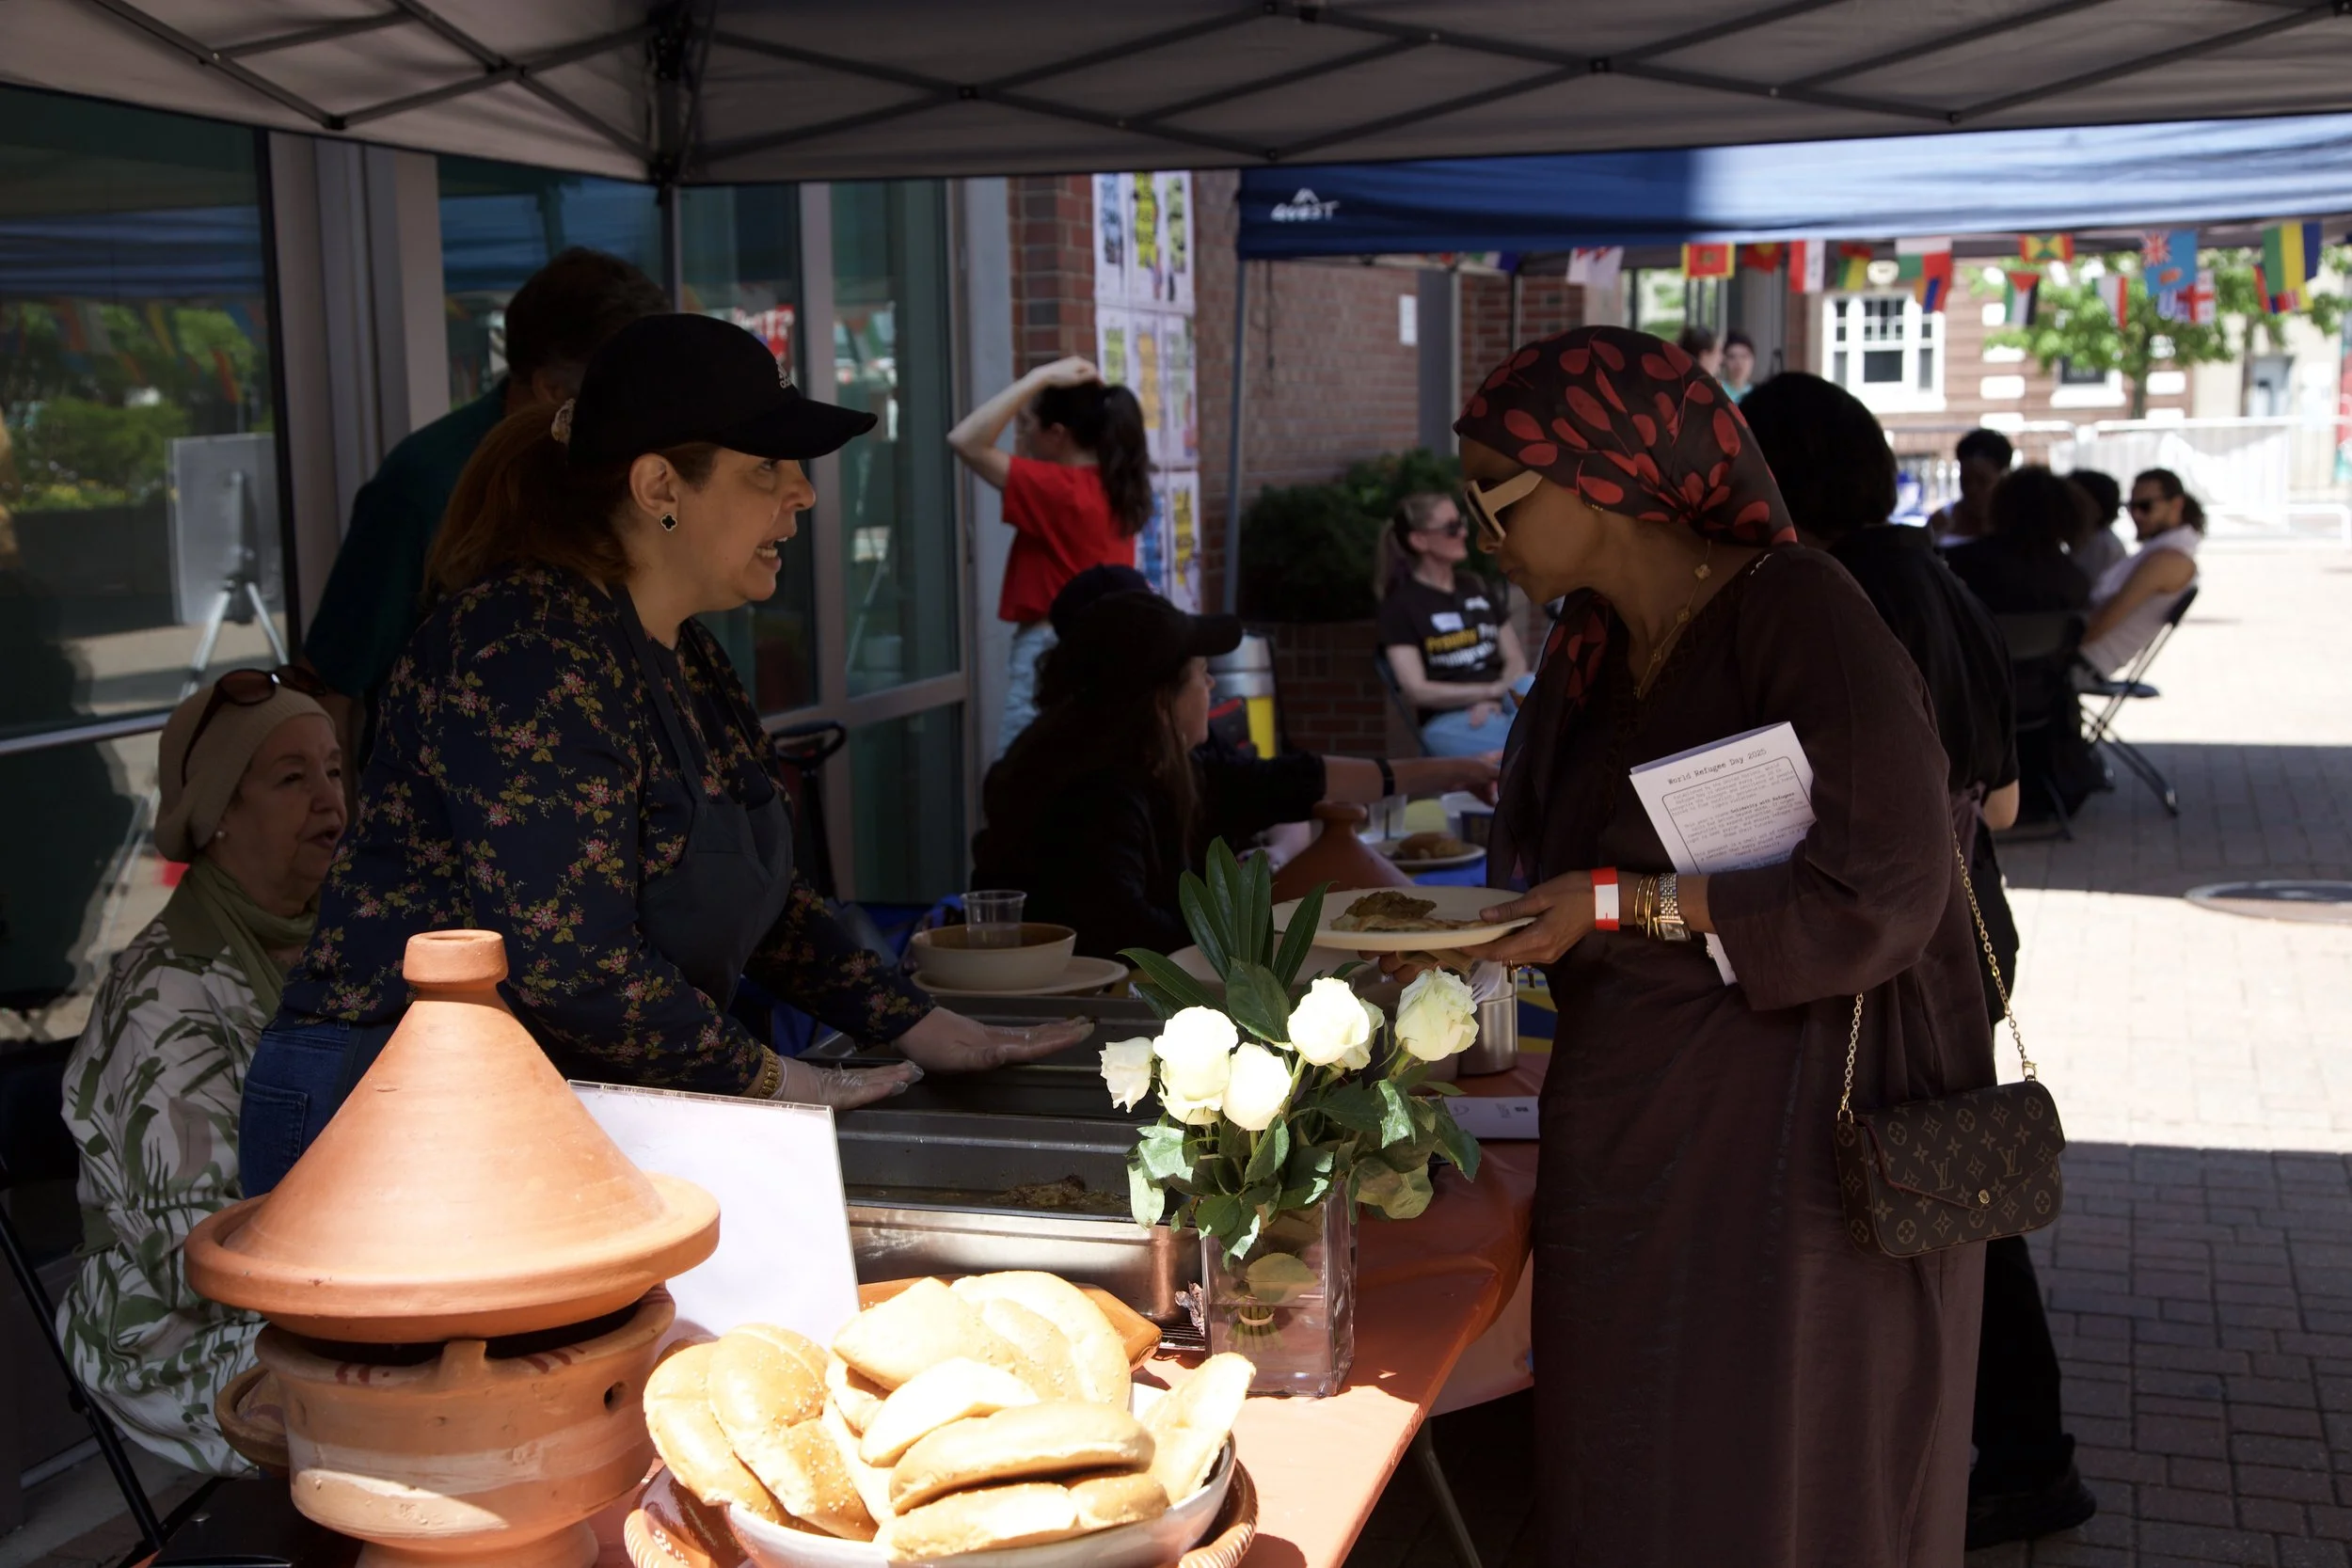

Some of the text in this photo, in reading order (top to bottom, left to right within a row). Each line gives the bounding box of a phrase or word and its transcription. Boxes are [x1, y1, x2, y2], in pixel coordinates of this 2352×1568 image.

[1668, 748, 1767, 785] World Refugee Day 2025
[1731, 801, 1758, 814] Solidarity
[1772, 791, 1795, 801] Refugees
[1930, 1157, 1955, 1192] LV
[1997, 1144, 2024, 1179] LV
